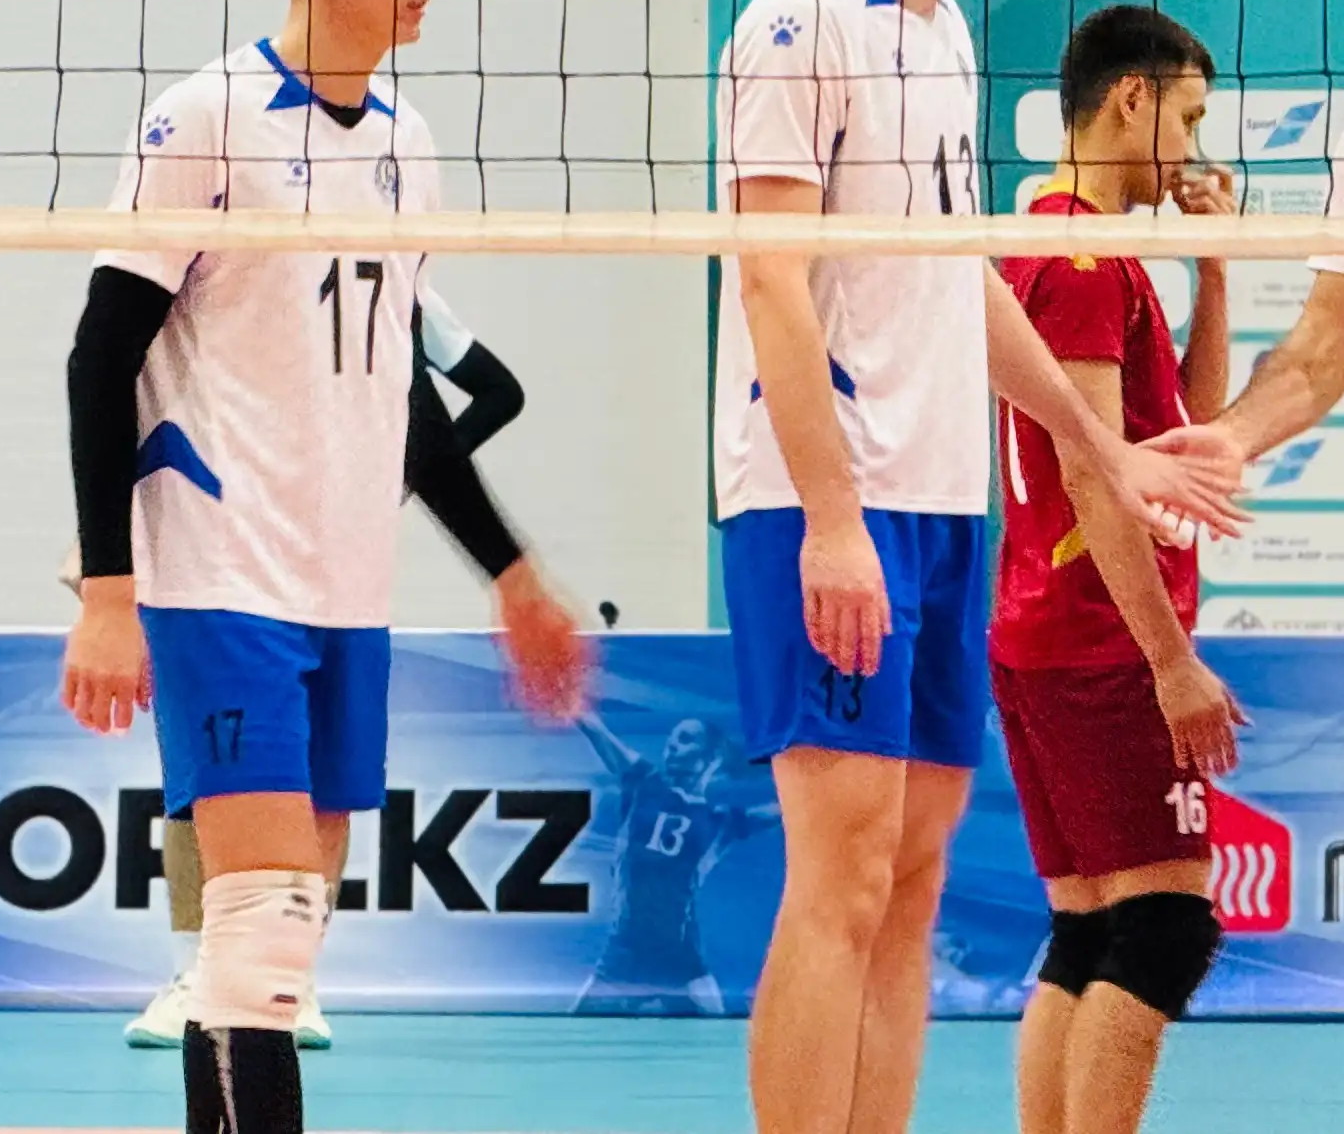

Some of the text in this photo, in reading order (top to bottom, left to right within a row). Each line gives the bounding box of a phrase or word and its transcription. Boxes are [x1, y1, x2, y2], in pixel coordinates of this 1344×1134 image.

[319, 258, 384, 375] 17
[818, 663, 863, 724] 13
[203, 709, 244, 765] 17
[646, 811, 692, 857] 13
[1164, 780, 1207, 835] 16
